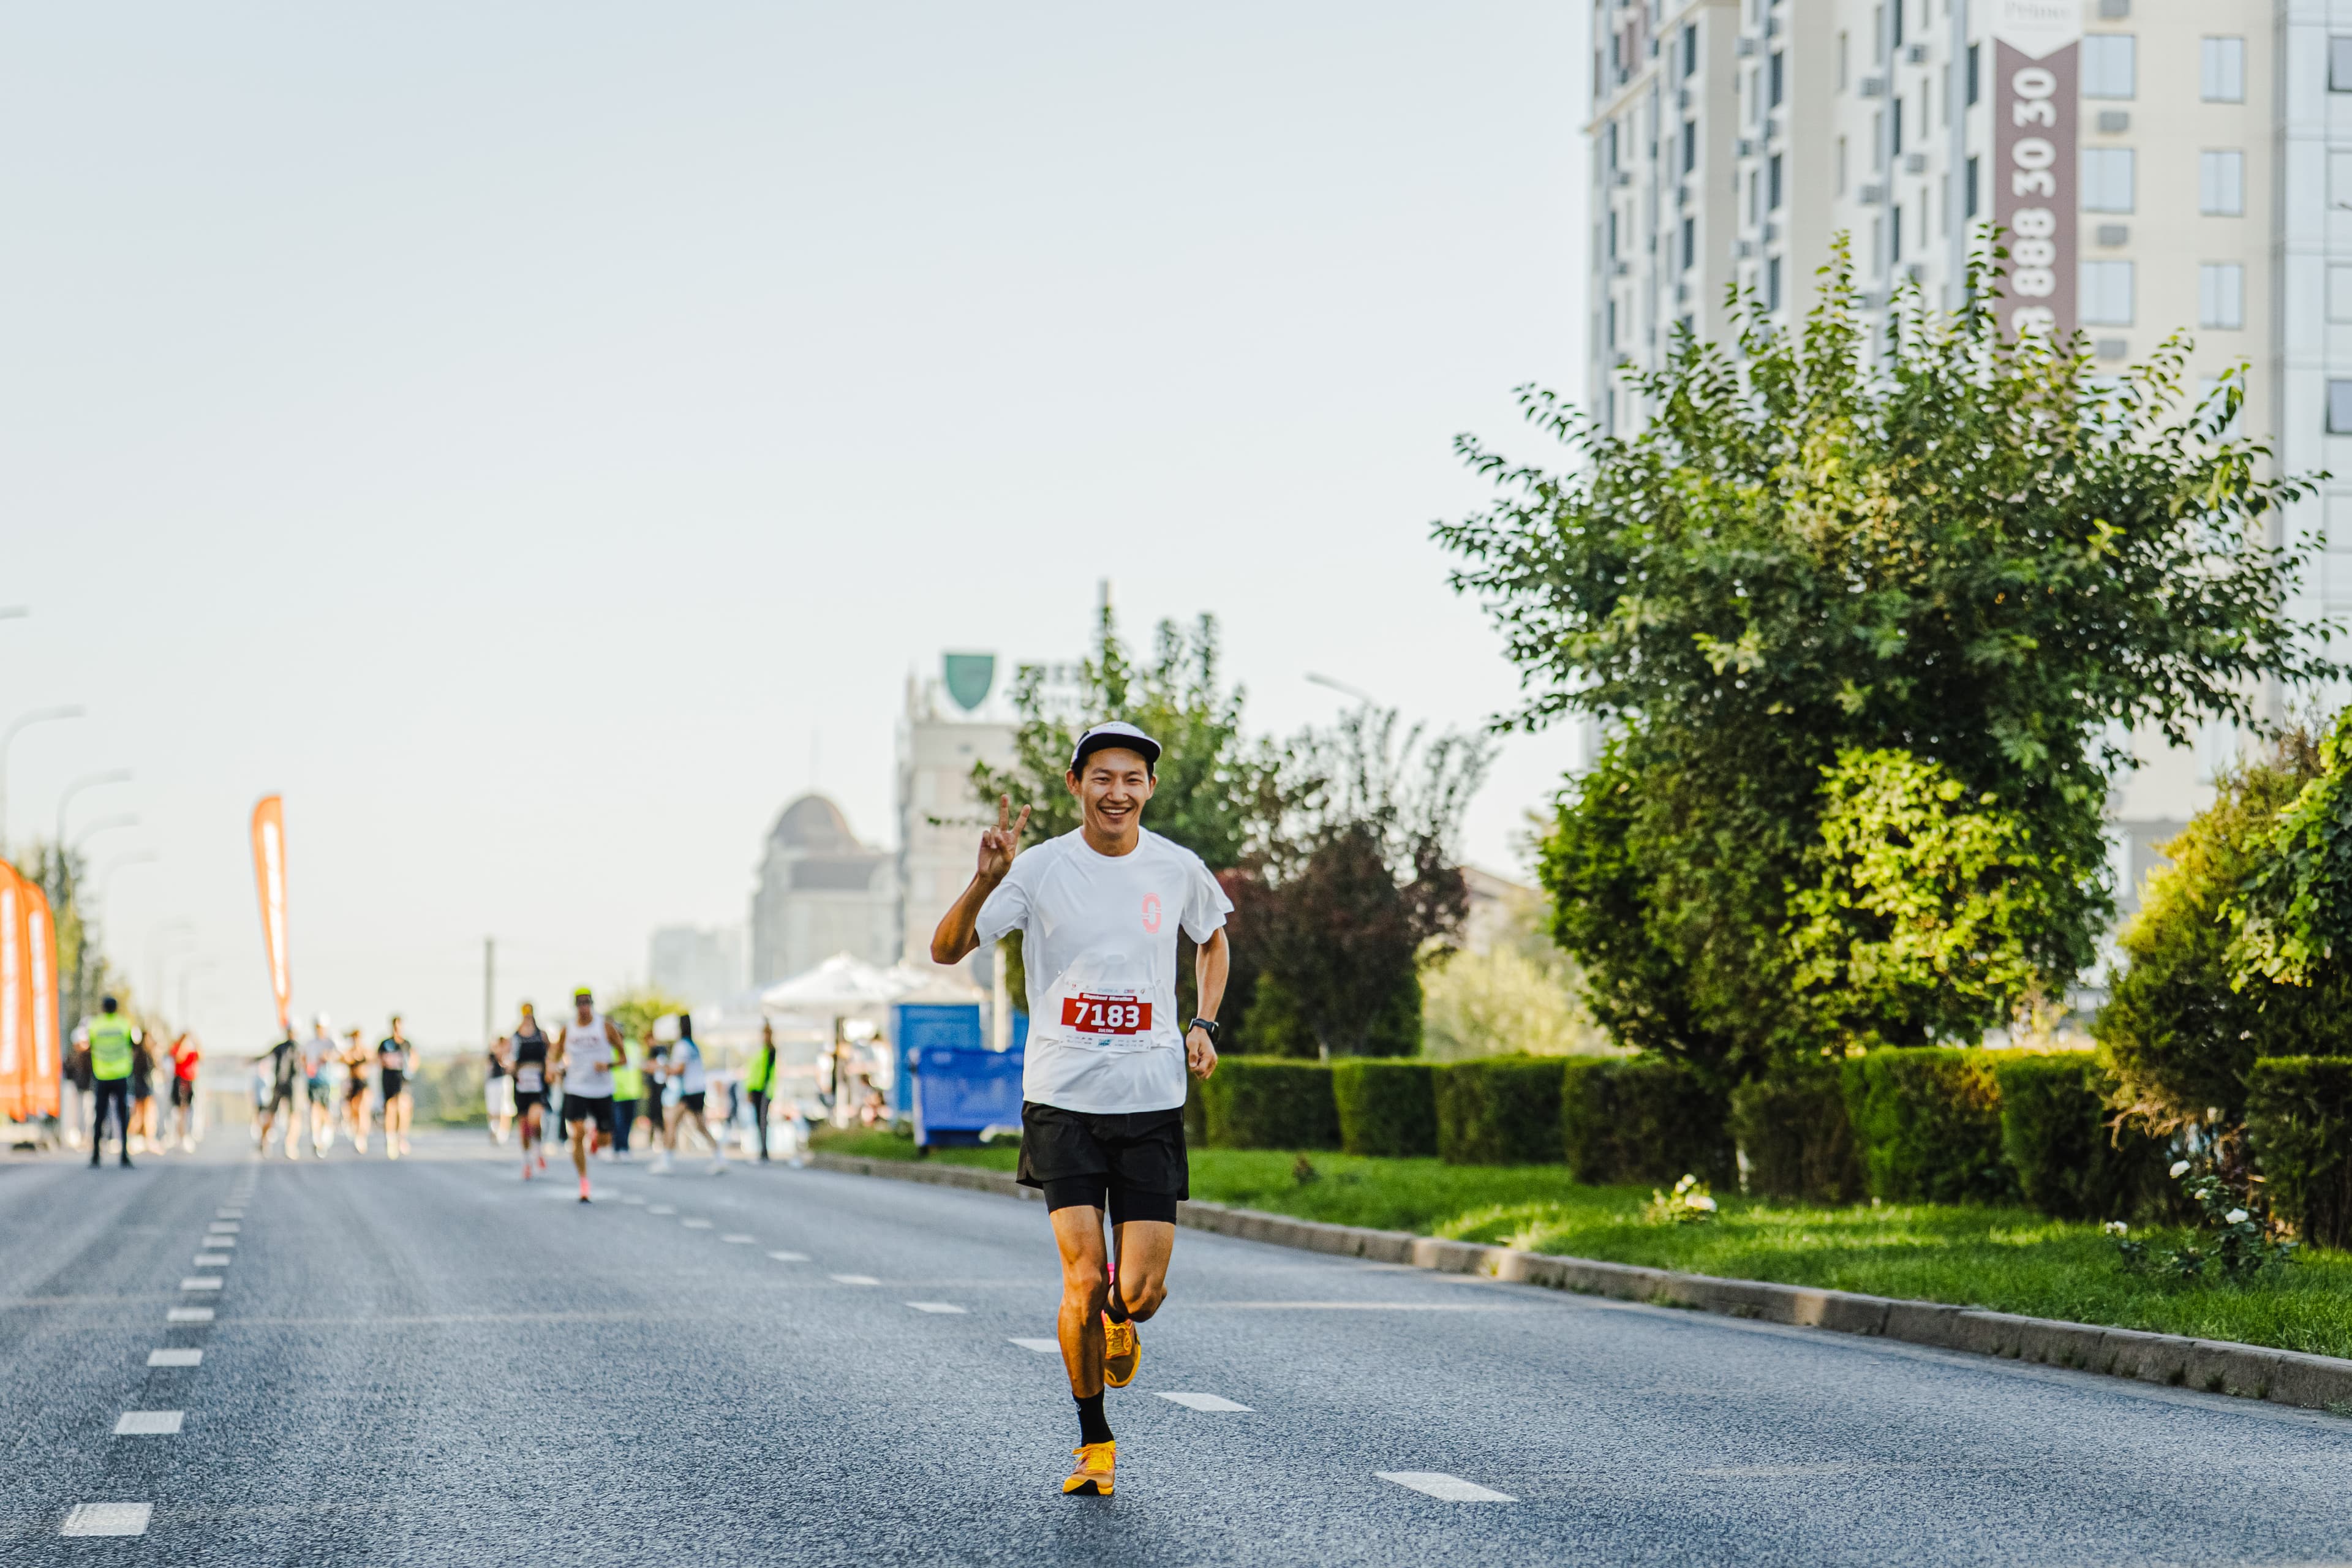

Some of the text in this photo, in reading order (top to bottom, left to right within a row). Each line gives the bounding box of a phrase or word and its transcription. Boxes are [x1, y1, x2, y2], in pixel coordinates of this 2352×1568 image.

[2011, 67, 2057, 127] 30
[2011, 138, 2056, 198] 30
[2011, 207, 2056, 298] 888
[1074, 1001, 1140, 1028] 7183
